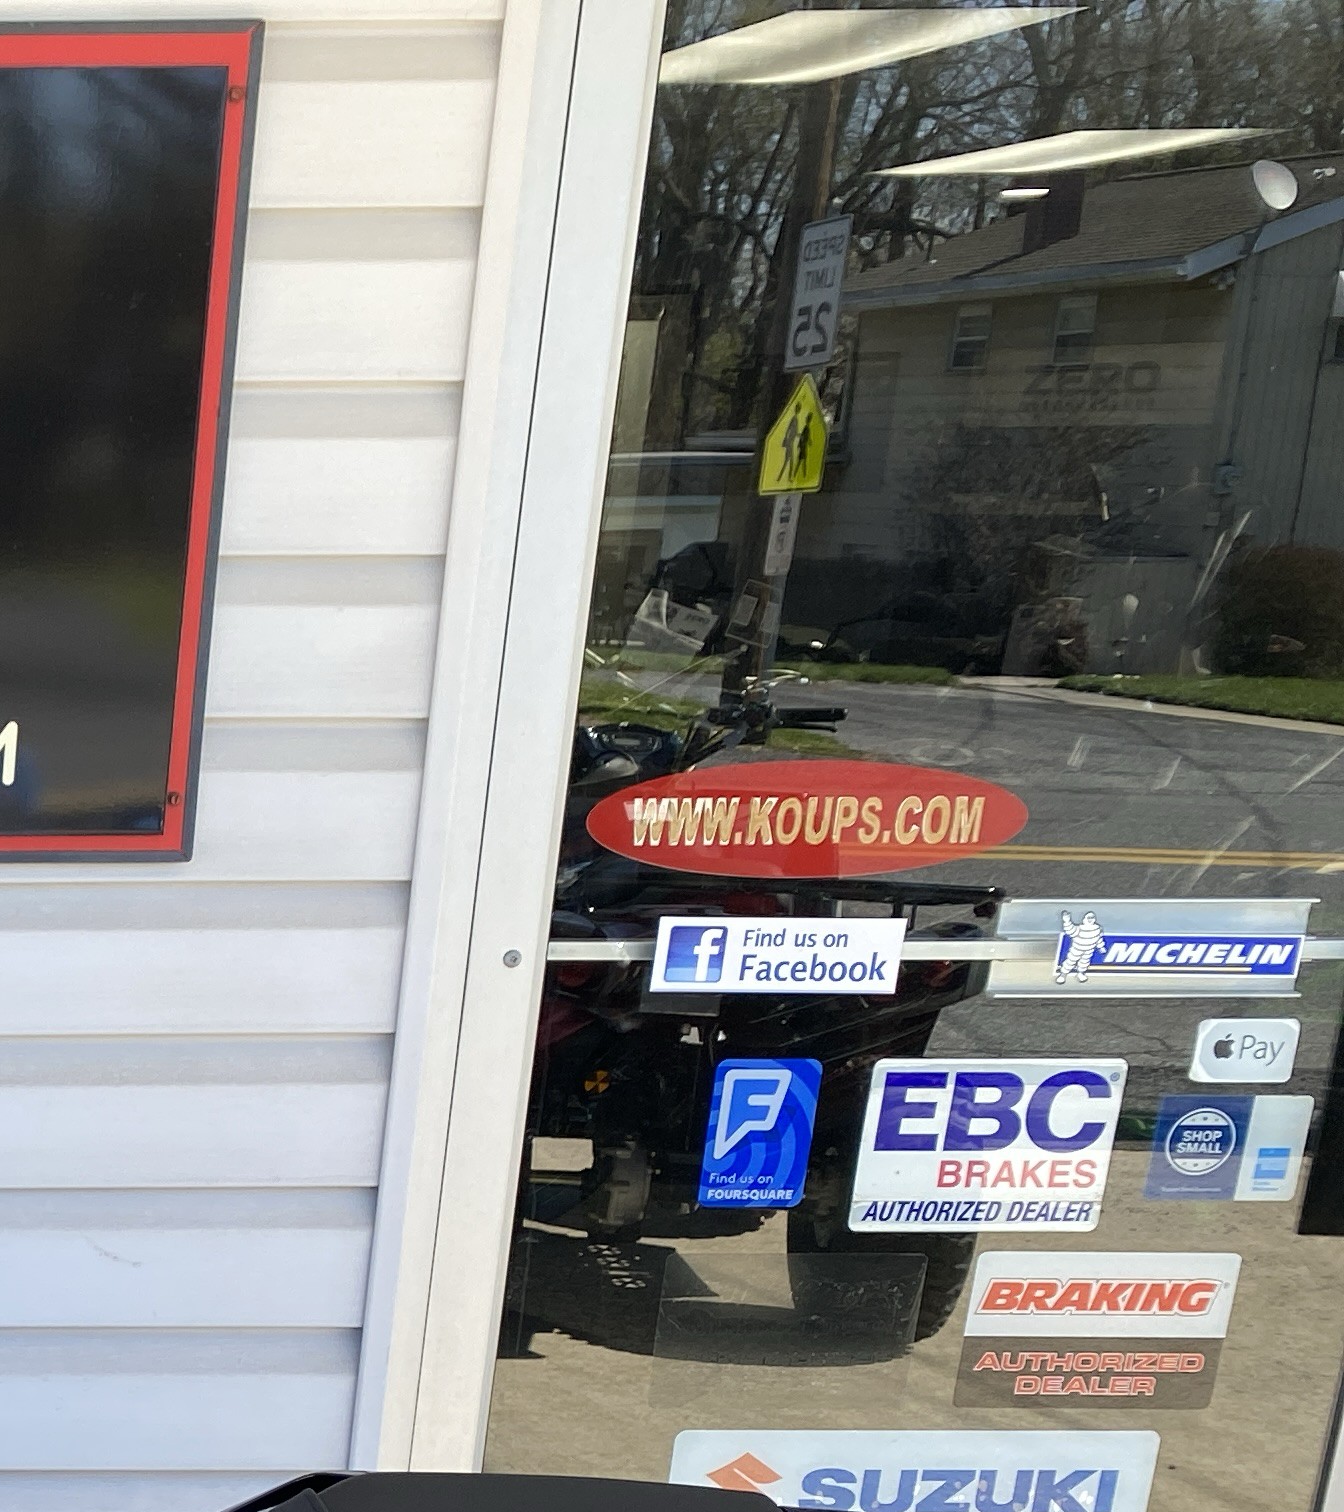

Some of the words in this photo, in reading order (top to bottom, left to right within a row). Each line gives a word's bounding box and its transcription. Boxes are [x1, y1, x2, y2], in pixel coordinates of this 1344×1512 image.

[632, 794, 986, 847] WWW.KOUPS.COM
[743, 927, 787, 949] Find
[795, 932, 817, 949] us
[823, 932, 849, 949] on
[1103, 942, 1294, 965] MICHELIN
[739, 952, 887, 982] Facebook
[1239, 1034, 1285, 1066] Pay
[873, 1070, 1113, 1152] EBC
[1182, 1130, 1223, 1142] SHOP
[1176, 1143, 1223, 1155] SMALL
[709, 1172, 736, 1185] Find
[739, 1174, 755, 1185] us
[757, 1174, 774, 1185] on
[936, 1159, 1097, 1189] BRAKES
[706, 1189, 794, 1201] FOURSQUARE
[861, 1200, 1002, 1223] AUTHORIZED
[1005, 1200, 1094, 1223] DEALER
[976, 1278, 1221, 1315] BRAKING
[973, 1352, 1206, 1373] AUTHORIZED
[1014, 1375, 1157, 1396] DEALER
